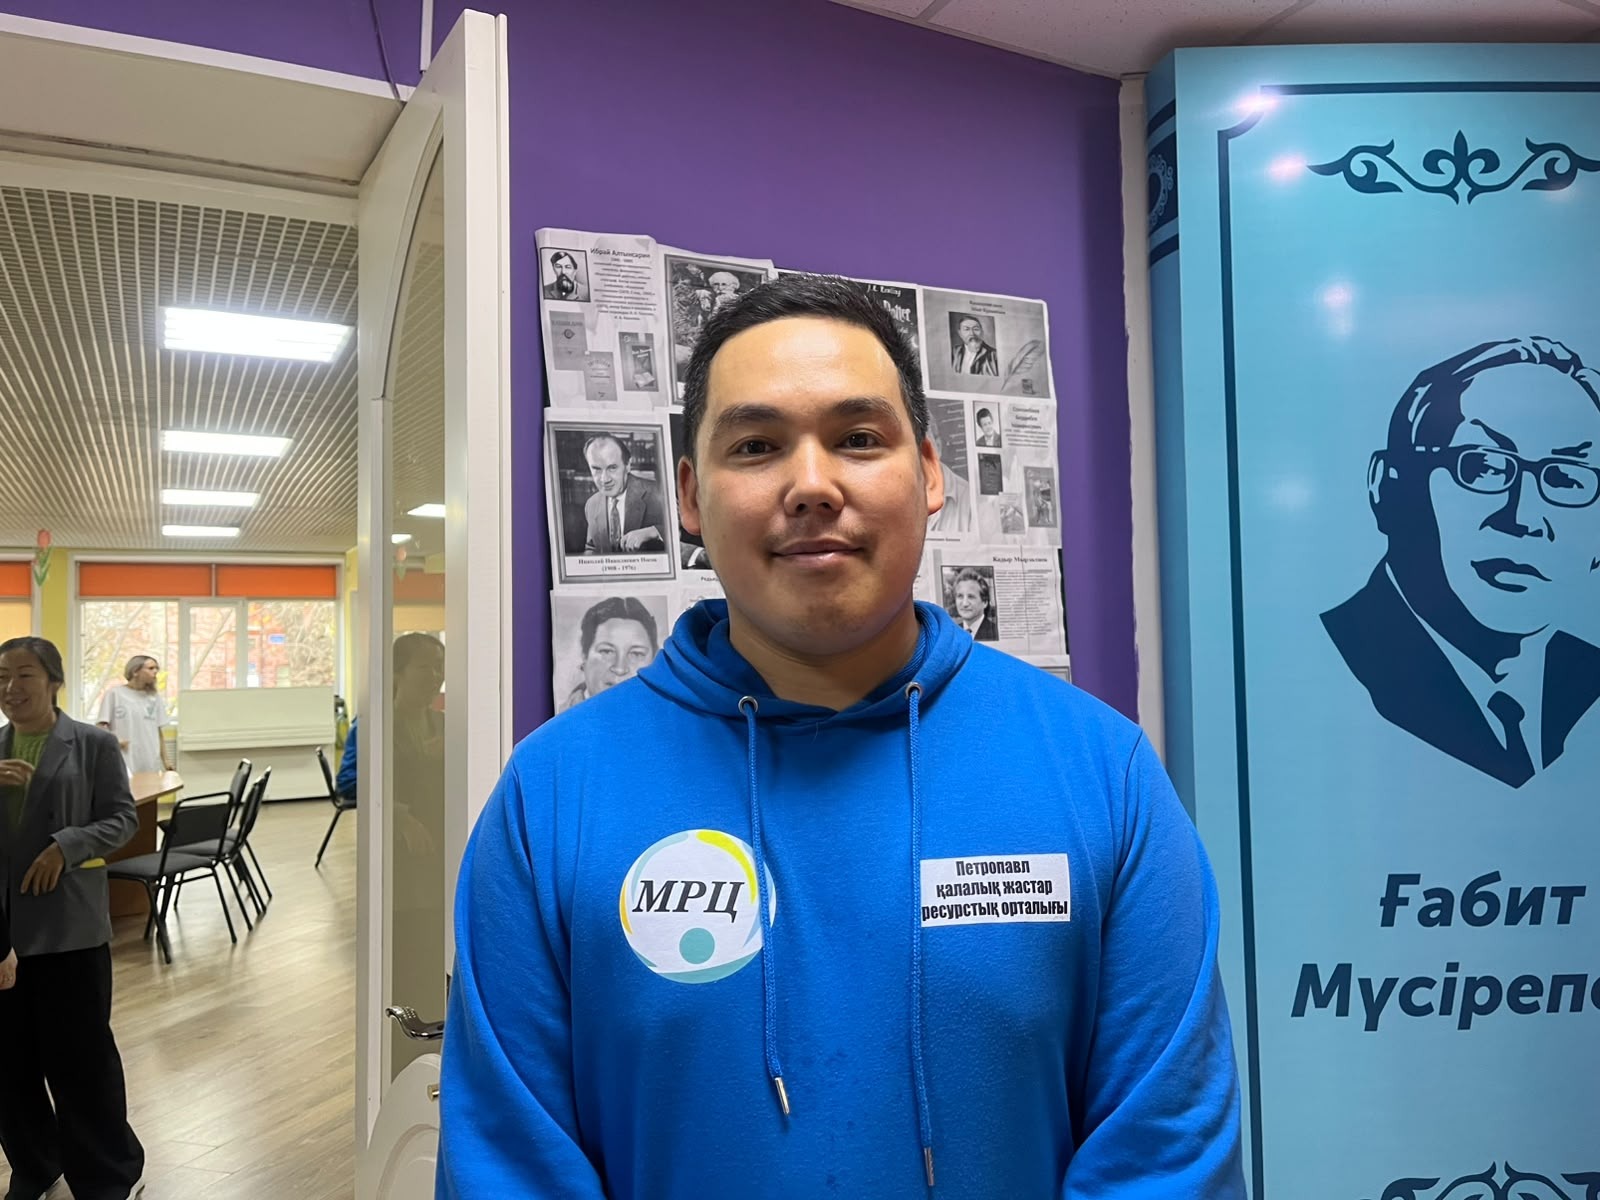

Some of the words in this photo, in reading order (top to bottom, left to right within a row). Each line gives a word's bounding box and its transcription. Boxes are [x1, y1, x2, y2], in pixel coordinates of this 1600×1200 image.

[956, 860, 1031, 876] Петропавл
[631, 879, 745, 924] МРЦ
[936, 880, 1002, 899] қалалық
[1002, 880, 1053, 895] жастар
[1379, 870, 1587, 928] Ғабит
[922, 901, 999, 921] ресурстық
[1001, 900, 1068, 917] орталығы
[1290, 961, 1600, 1032] Мүсіреп
